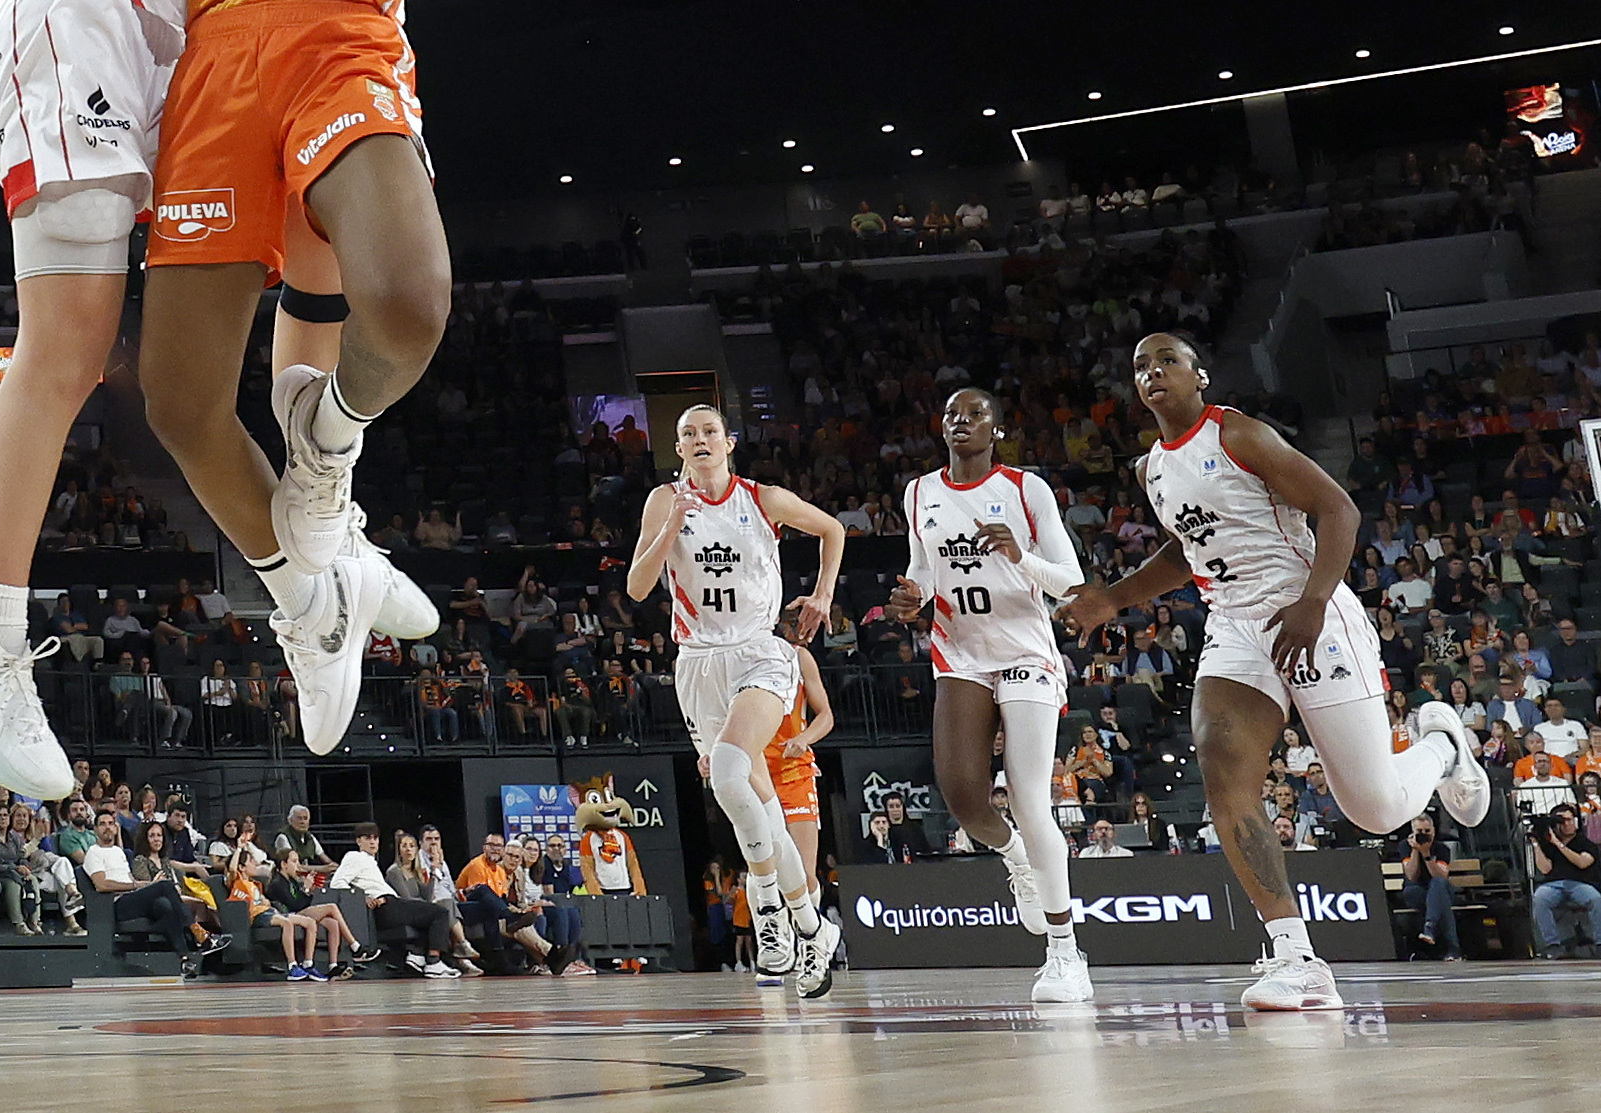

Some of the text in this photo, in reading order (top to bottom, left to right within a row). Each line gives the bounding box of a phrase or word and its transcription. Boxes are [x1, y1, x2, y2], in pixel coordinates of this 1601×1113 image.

[297, 111, 367, 166] Vitaldin
[157, 201, 228, 222] PULEVA
[1205, 557, 1238, 583] 2
[702, 587, 737, 613] 41
[951, 586, 992, 615] 10
[882, 900, 1022, 936] quirónsalu
[1069, 892, 1212, 923] KGM
